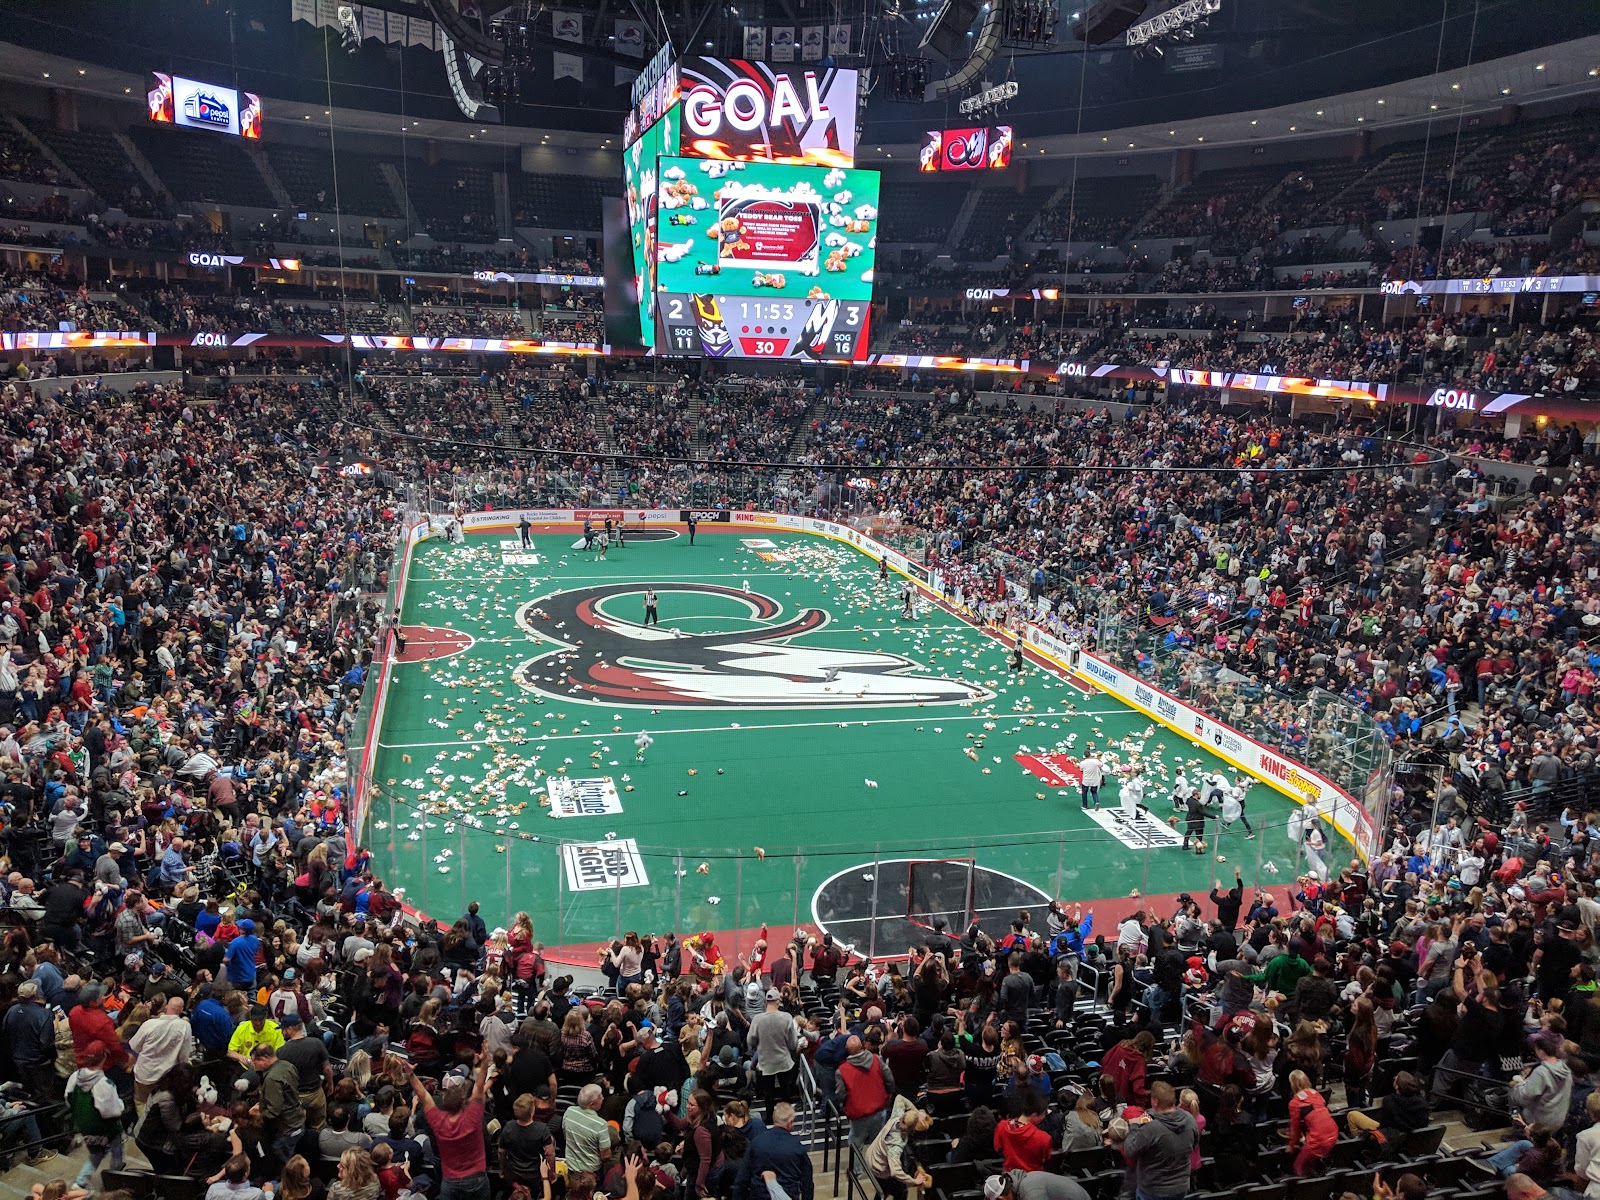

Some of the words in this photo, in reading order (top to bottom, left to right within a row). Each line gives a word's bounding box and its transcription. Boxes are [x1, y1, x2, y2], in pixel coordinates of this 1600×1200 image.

[685, 71, 830, 136] GOAL
[210, 108, 228, 119] pepsi
[1380, 282, 1402, 295] GOAL
[1535, 281, 1541, 290] 3
[668, 300, 682, 319] 2
[741, 302, 794, 320] 11:53
[846, 307, 860, 325] 3
[197, 332, 227, 346] GOAL
[677, 338, 691, 348] 11
[755, 342, 774, 354] 30
[836, 343, 850, 353] 16
[1060, 362, 1087, 376] GOAL
[1434, 388, 1476, 410] GOAL
[343, 466, 362, 474] GOAL
[1086, 661, 1099, 674] BUD
[1099, 666, 1116, 684] LIGHT
[1135, 684, 1153, 700] Altitude
[1158, 696, 1176, 714] Altitude
[1261, 754, 1287, 780] KING
[1288, 768, 1320, 798] Soopers
[576, 846, 607, 884] LIGHT
[601, 849, 629, 876] BUD
